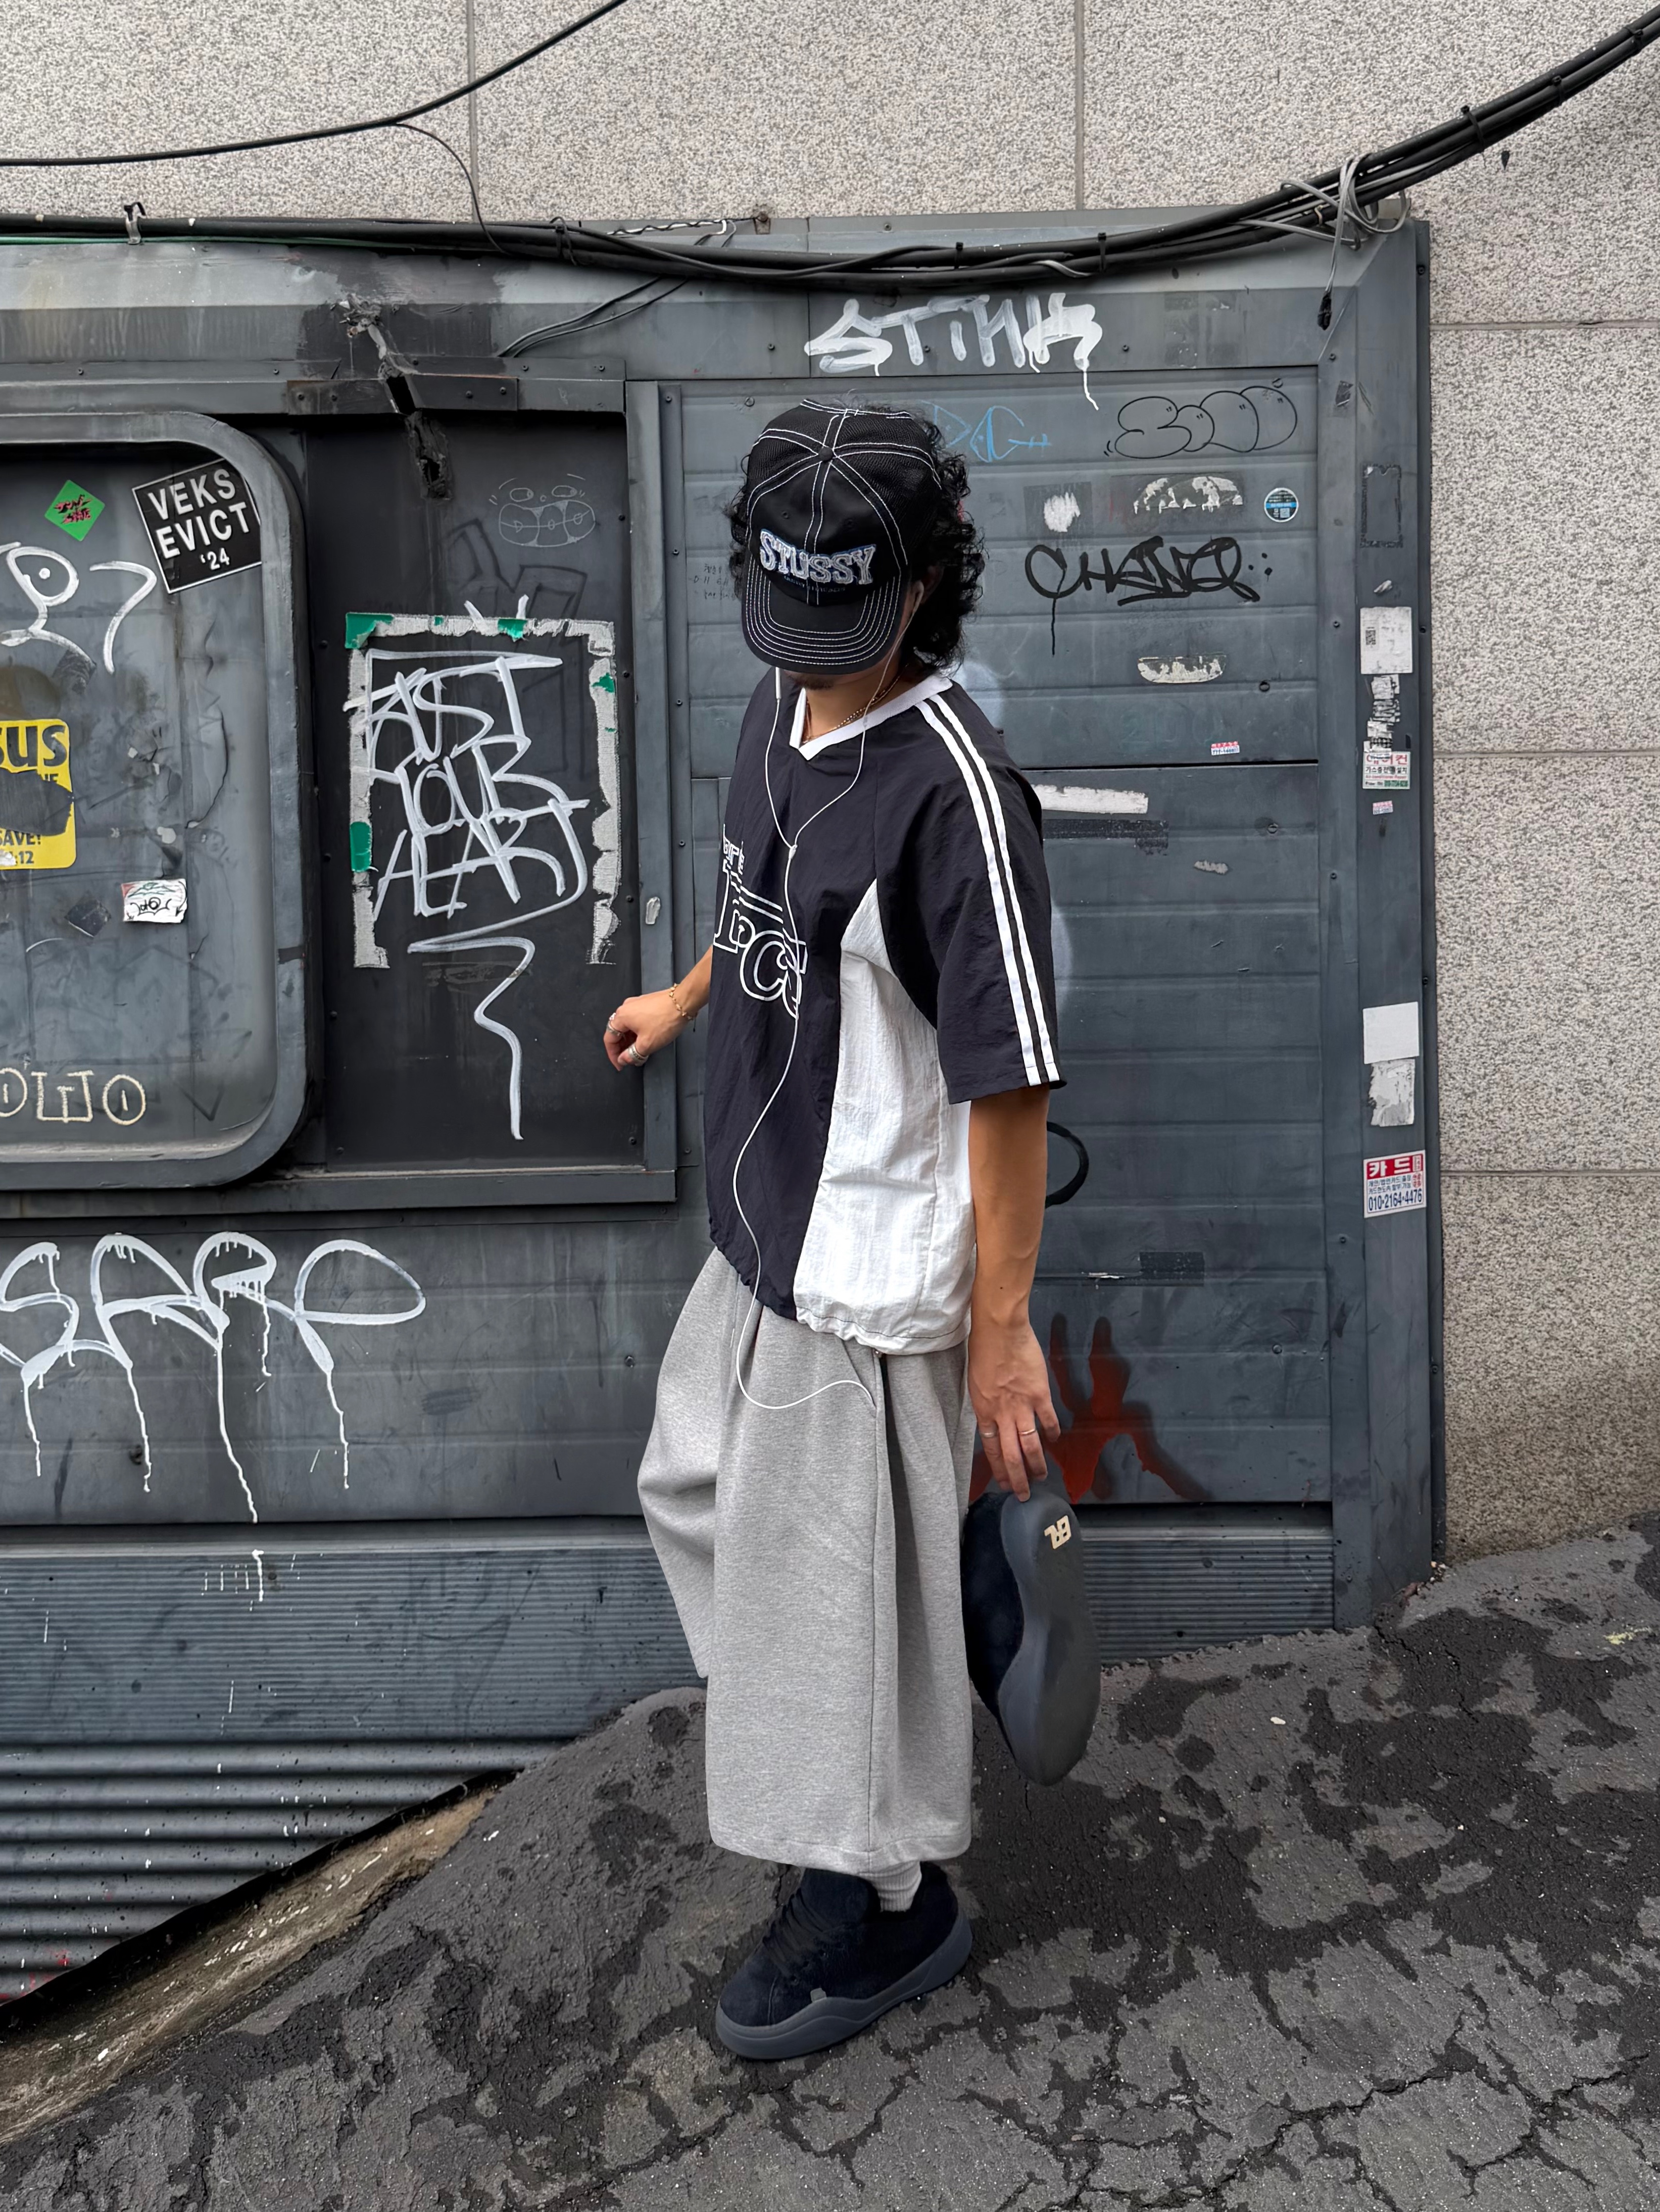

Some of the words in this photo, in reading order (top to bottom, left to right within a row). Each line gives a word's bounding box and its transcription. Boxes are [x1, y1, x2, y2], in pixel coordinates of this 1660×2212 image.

[148, 469, 235, 520] VEKS
[156, 501, 249, 559] EVICT
[759, 528, 877, 585] STUSSY
[0, 725, 68, 767] us
